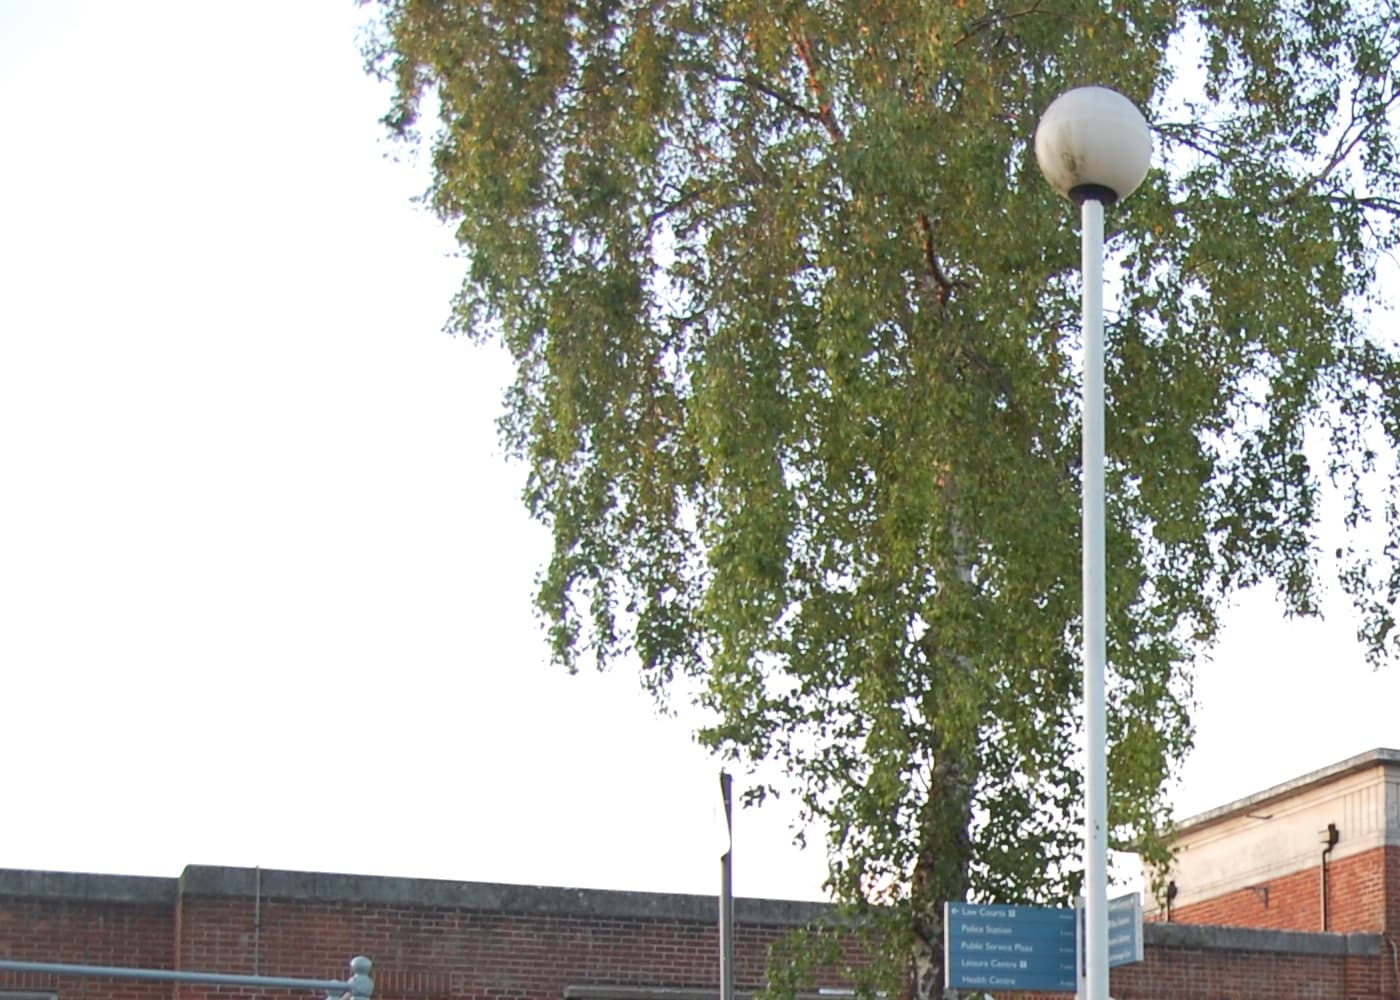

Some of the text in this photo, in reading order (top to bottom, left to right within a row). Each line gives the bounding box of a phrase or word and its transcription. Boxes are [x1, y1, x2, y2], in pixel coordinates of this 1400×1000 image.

[979, 908, 1006, 917] Courts
[961, 924, 1012, 934] Police Station
[961, 941, 1033, 952] Public Service Plaza
[961, 959, 1017, 968] Leisure Centre
[962, 976, 1016, 985] Health Centre
